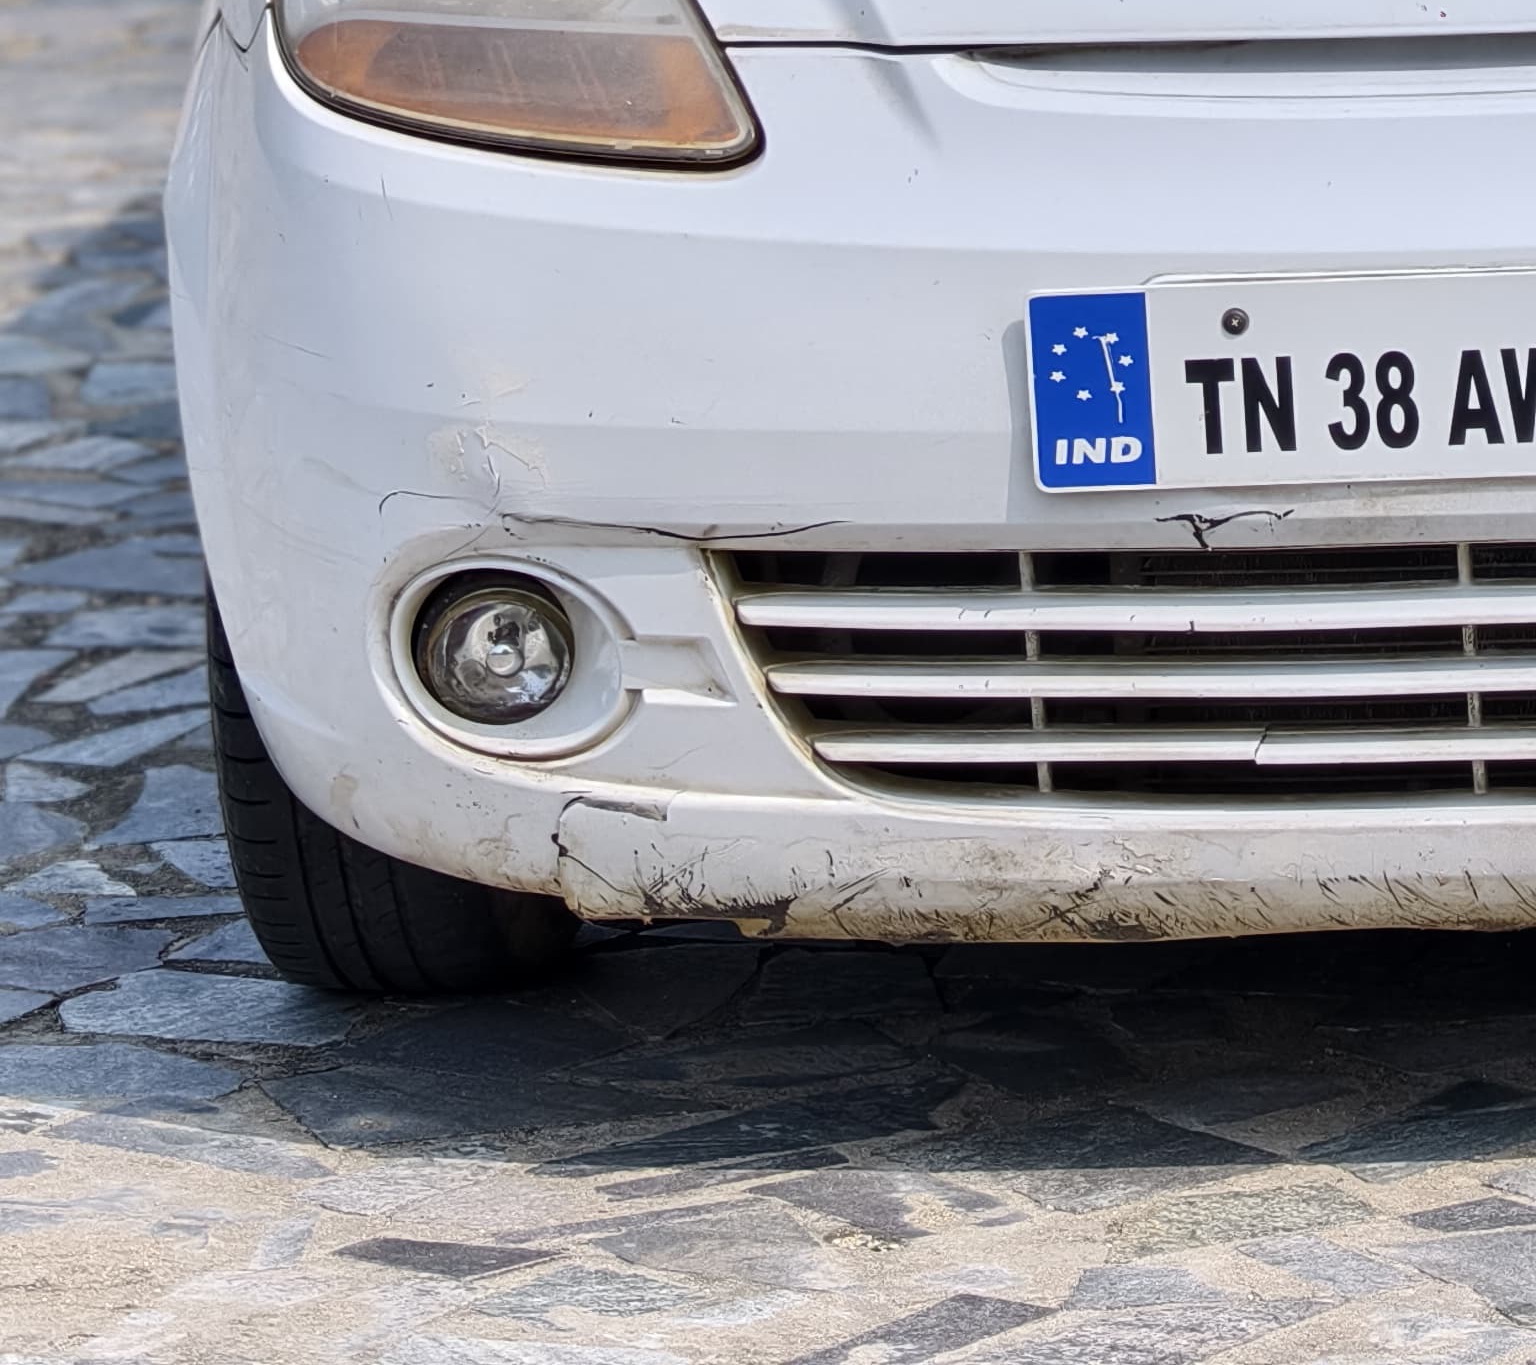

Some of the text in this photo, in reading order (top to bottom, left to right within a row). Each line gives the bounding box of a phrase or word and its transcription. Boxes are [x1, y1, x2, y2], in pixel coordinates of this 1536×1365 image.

[1185, 355, 1296, 455] TN
[1324, 352, 1420, 451] 38
[1054, 436, 1142, 465] IND
